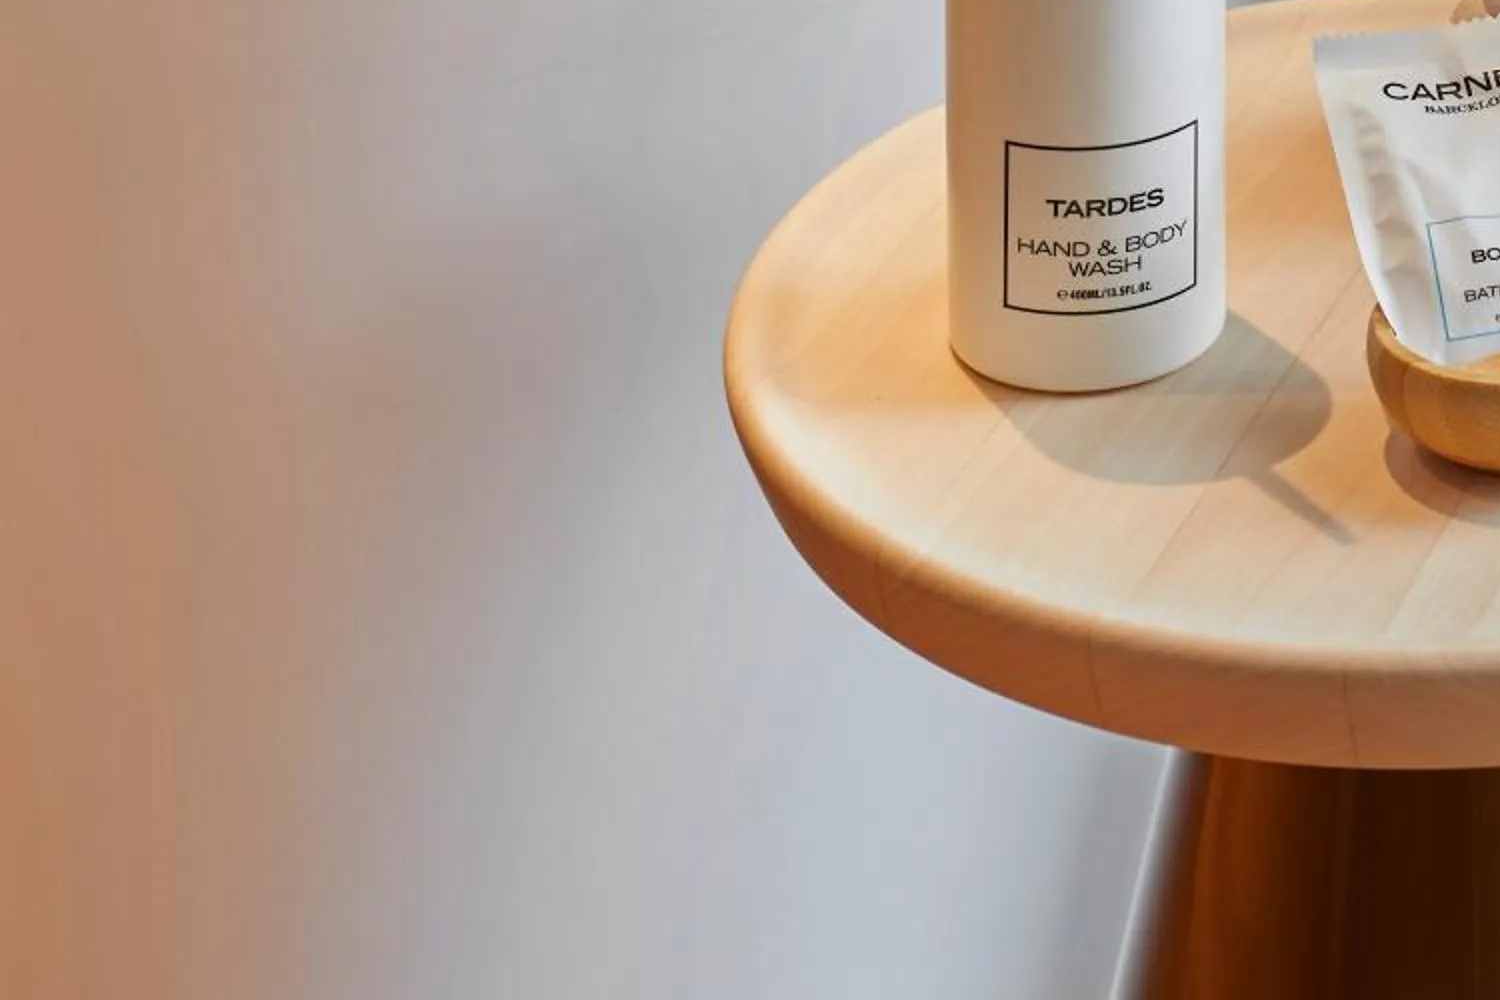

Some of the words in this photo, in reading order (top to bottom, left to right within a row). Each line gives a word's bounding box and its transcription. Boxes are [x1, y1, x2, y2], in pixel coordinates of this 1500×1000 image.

[1046, 188, 1164, 219] TARDES
[1017, 237, 1090, 258] HAND
[1098, 240, 1117, 257] &
[1125, 219, 1187, 252] BODY
[1068, 256, 1142, 278] WASH
